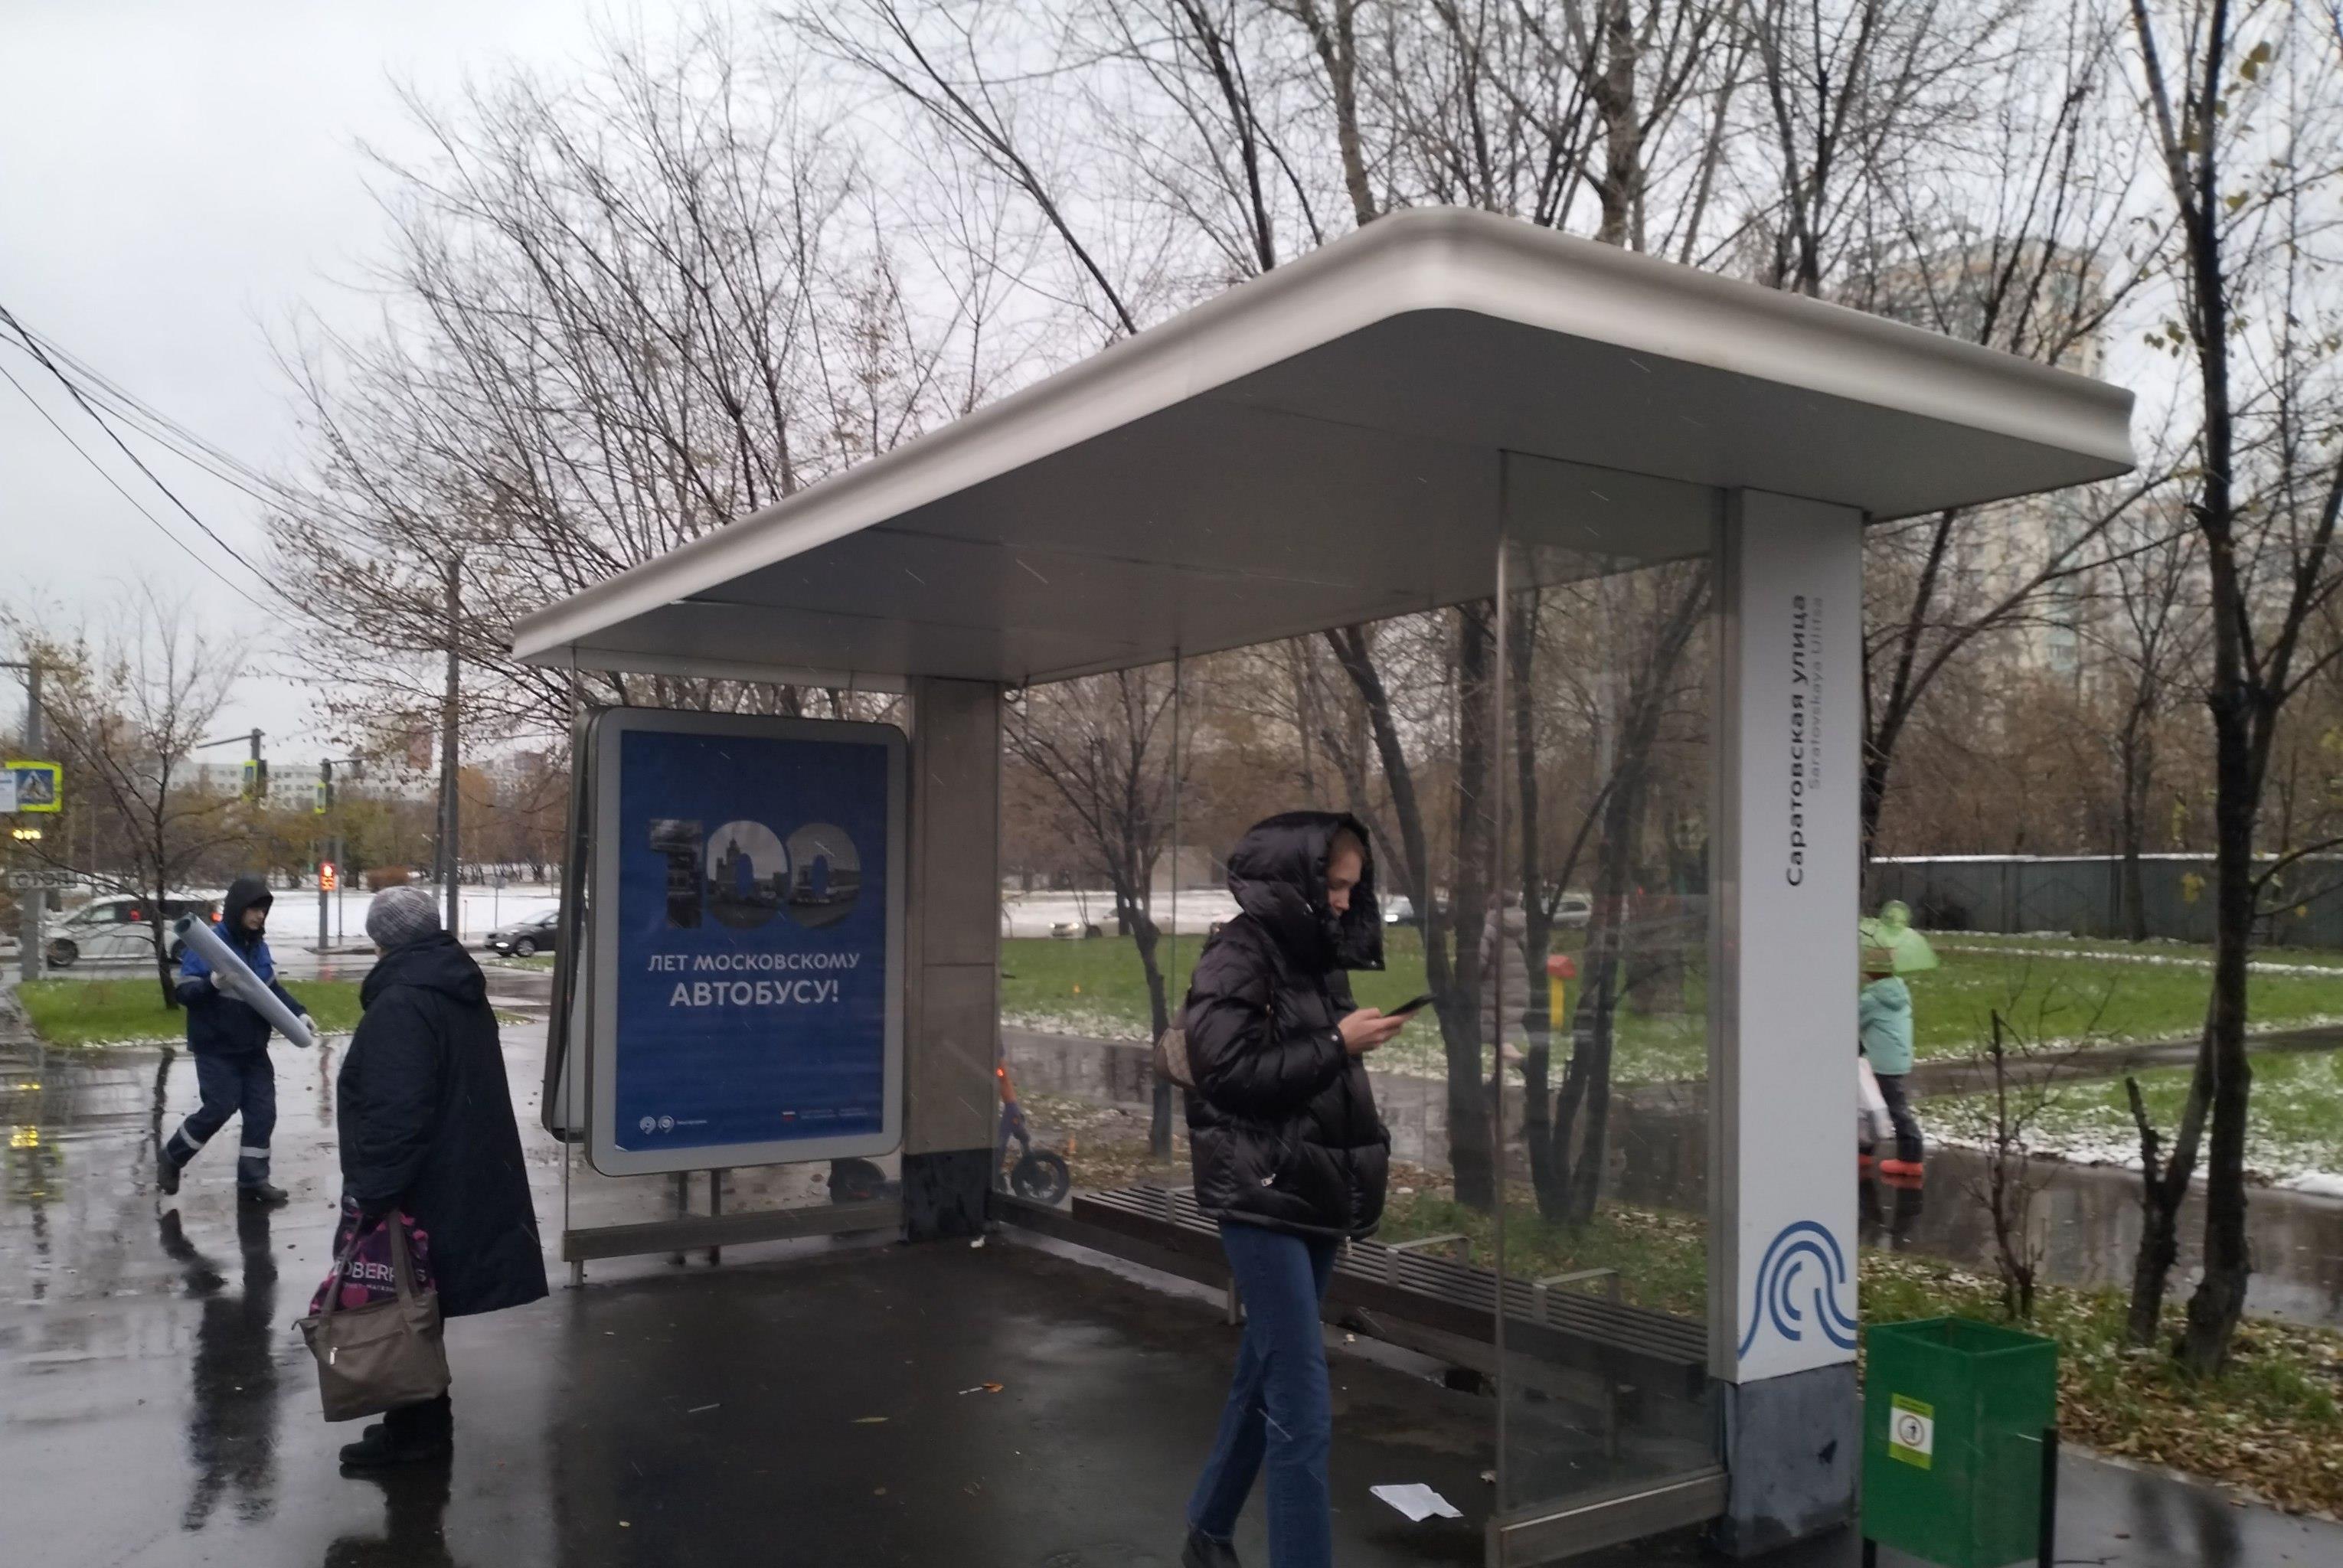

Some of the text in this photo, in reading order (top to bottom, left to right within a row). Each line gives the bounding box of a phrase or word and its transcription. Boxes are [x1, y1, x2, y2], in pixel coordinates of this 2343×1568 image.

[1786, 595, 1809, 887] Саратовская улица
[650, 819, 861, 929] 100
[648, 953, 861, 971] ЛЕТ МОСКОВСКОМУ
[669, 980, 840, 1007] АВТОБУСУ!
